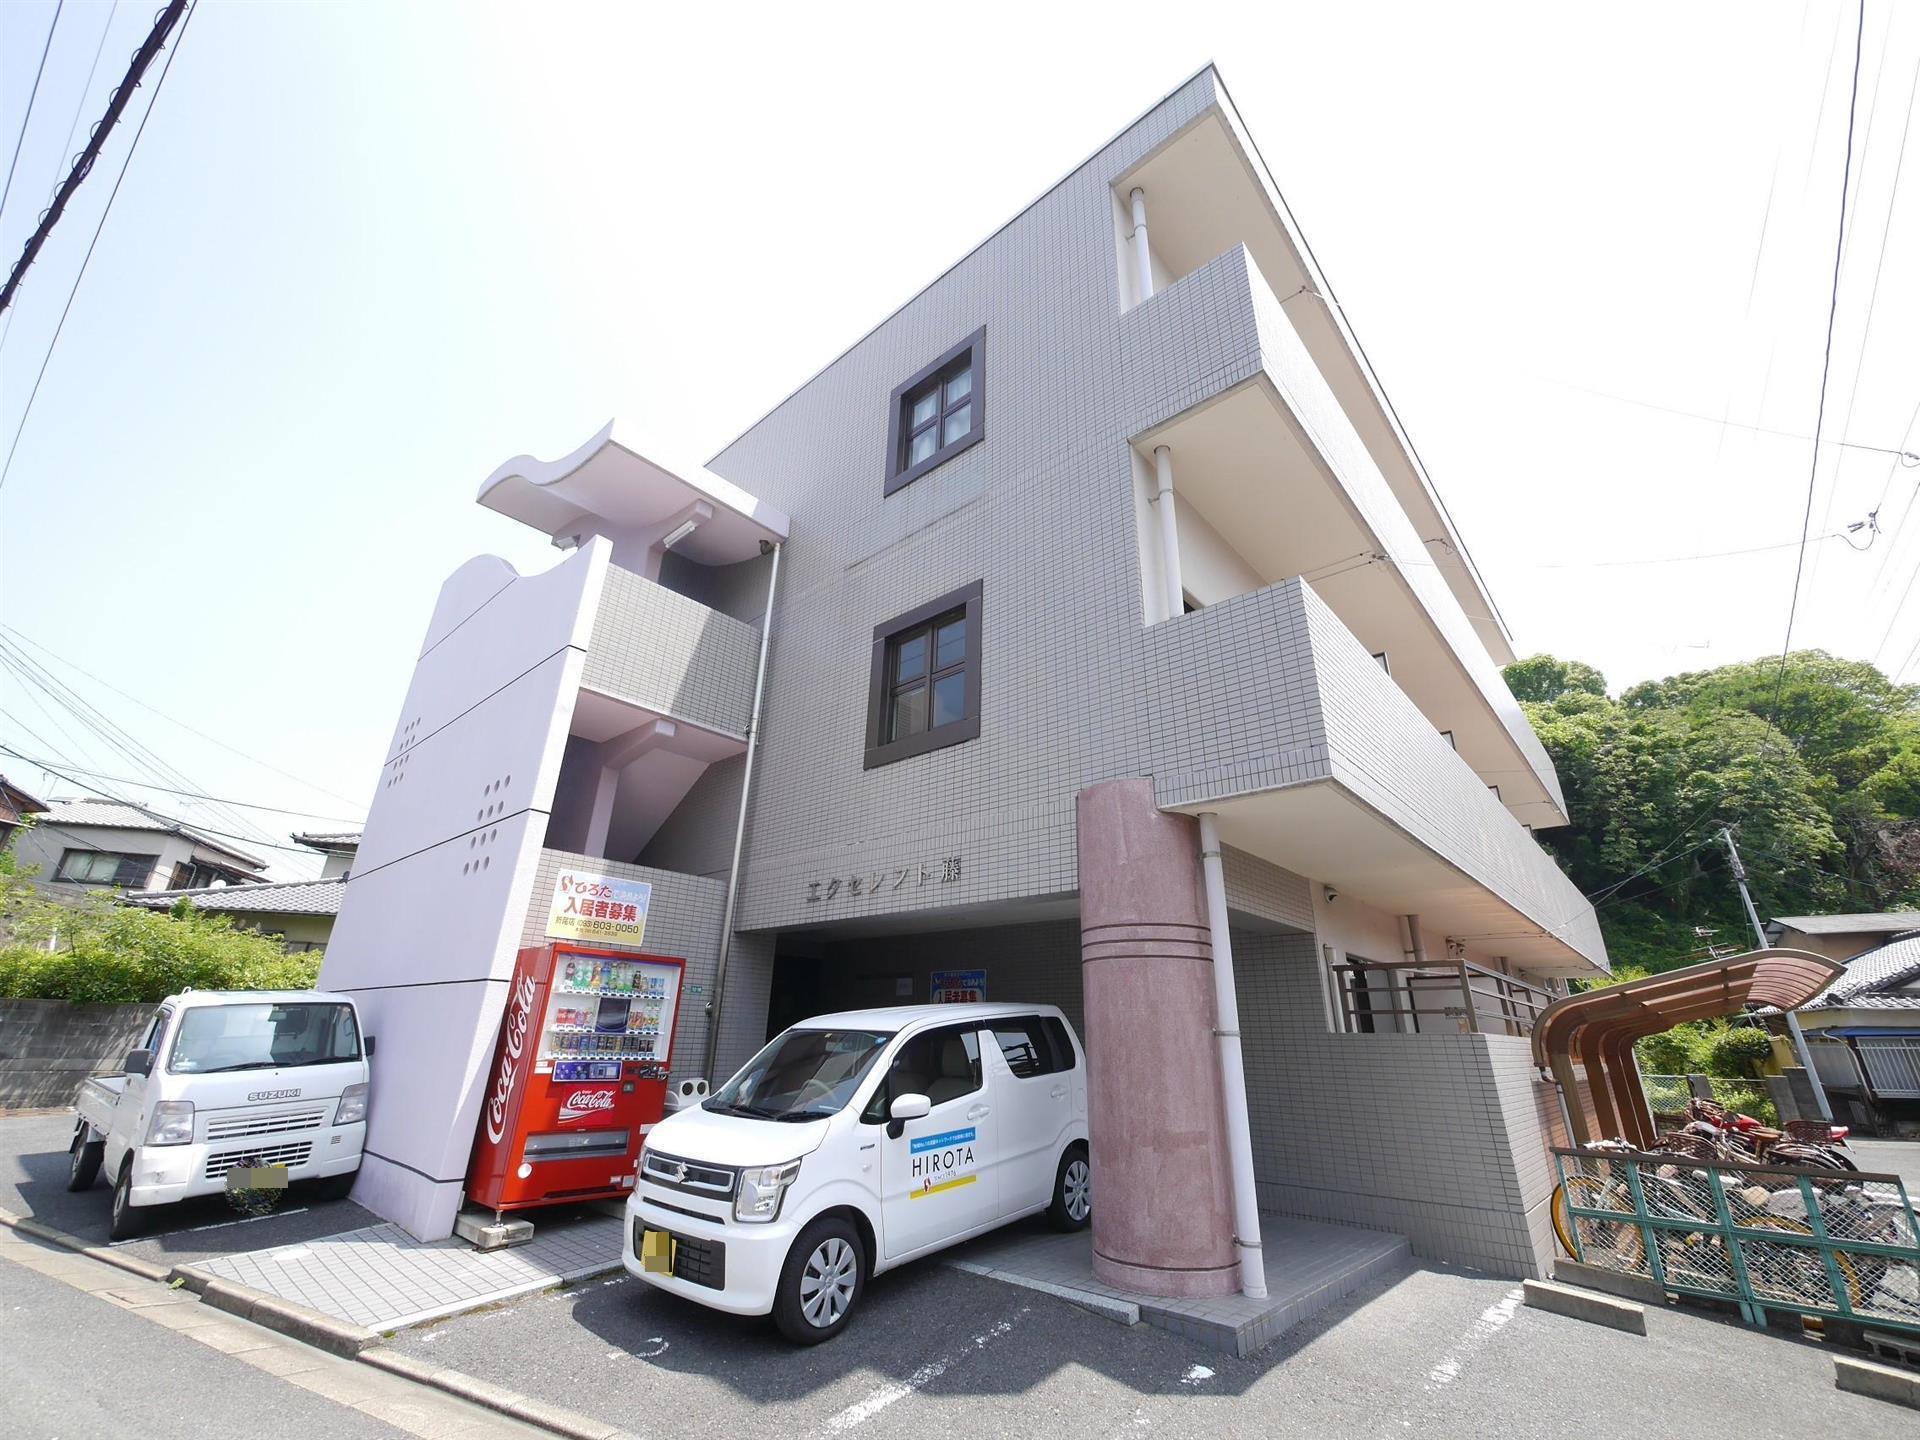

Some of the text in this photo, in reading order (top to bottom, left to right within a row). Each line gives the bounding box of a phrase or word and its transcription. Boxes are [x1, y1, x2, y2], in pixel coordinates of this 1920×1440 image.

[575, 881, 613, 898] ひろた
[563, 896, 637, 922] 入居者募集
[487, 966, 536, 1145] Coca-Cola
[247, 1088, 301, 1101] SUZUKI
[566, 1089, 616, 1109] Coca-Cola
[912, 1146, 974, 1177] HIROTA
